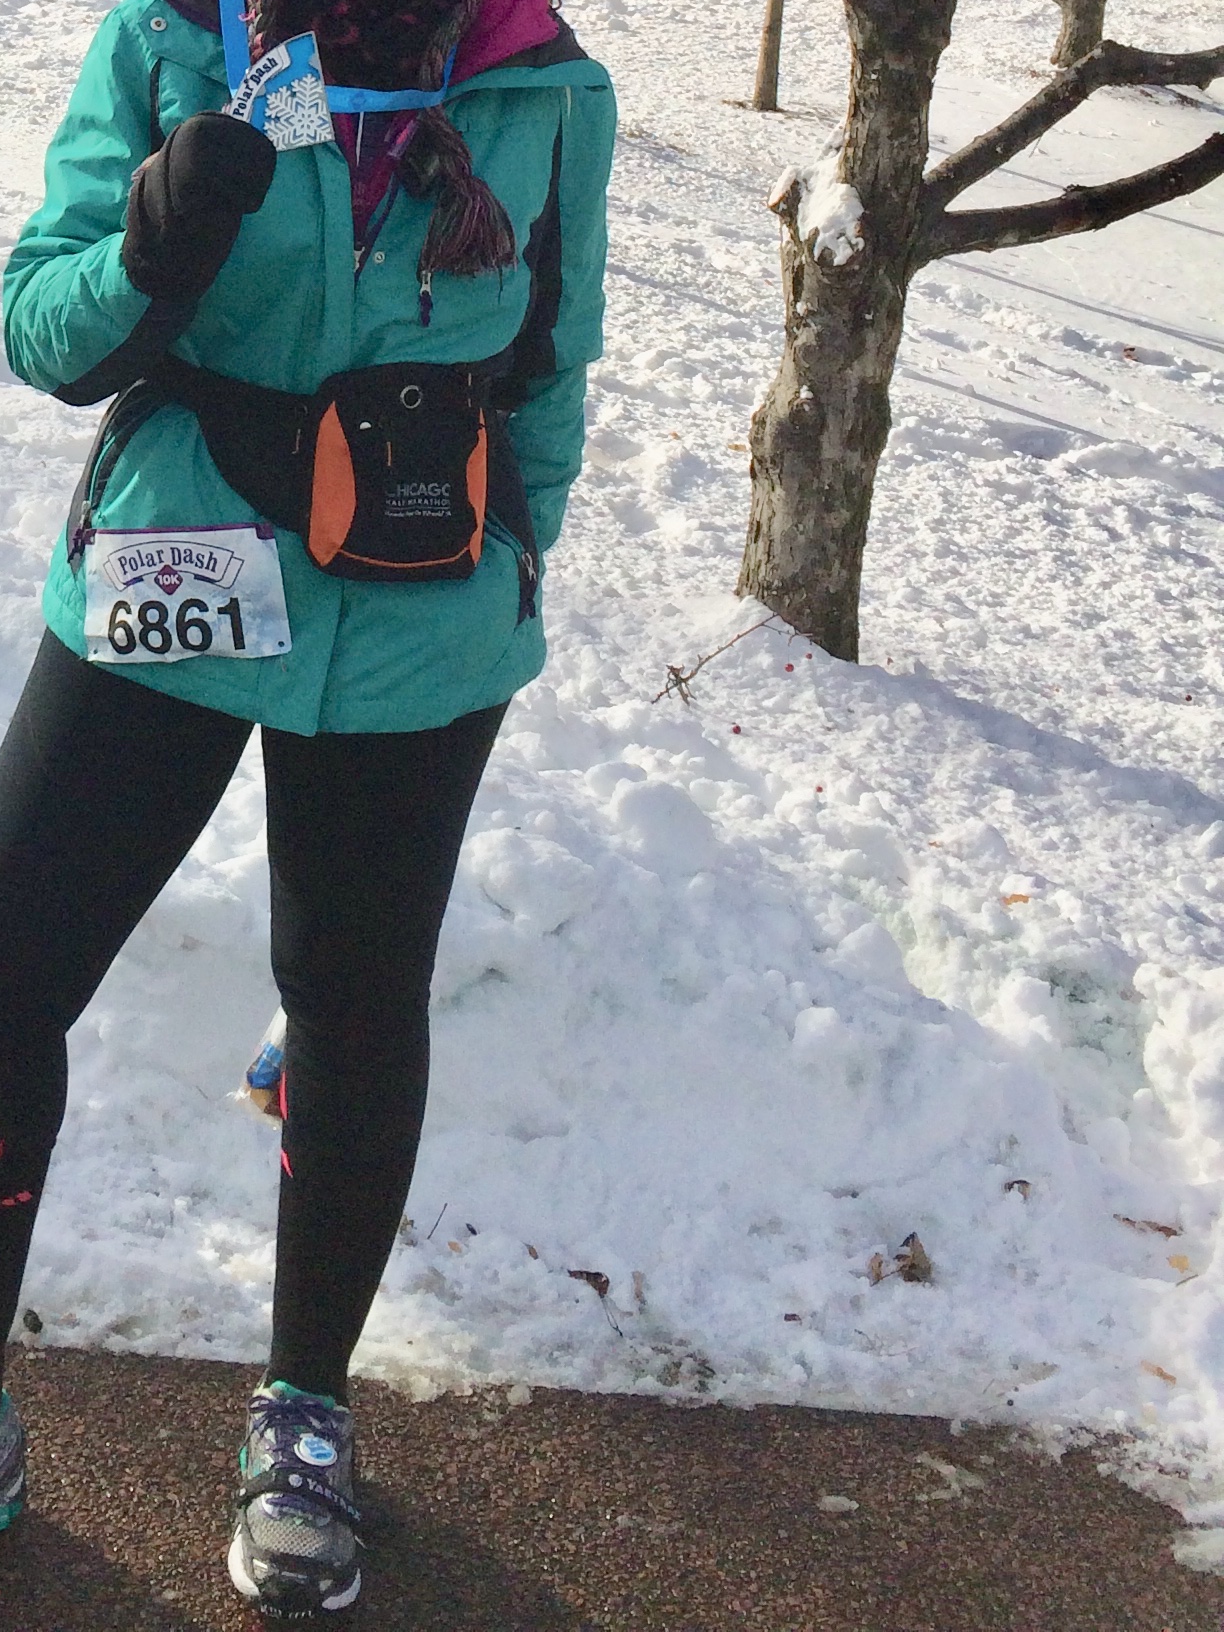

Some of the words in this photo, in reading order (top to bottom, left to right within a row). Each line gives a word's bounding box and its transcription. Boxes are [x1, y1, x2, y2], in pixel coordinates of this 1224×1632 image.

[232, 79, 254, 118] Polar
[249, 56, 279, 86] Dash
[407, 498, 451, 507] MARATHO
[117, 547, 165, 576] Polar
[170, 546, 219, 574] Dash
[156, 573, 182, 586] 10K
[107, 597, 247, 655] 6861
